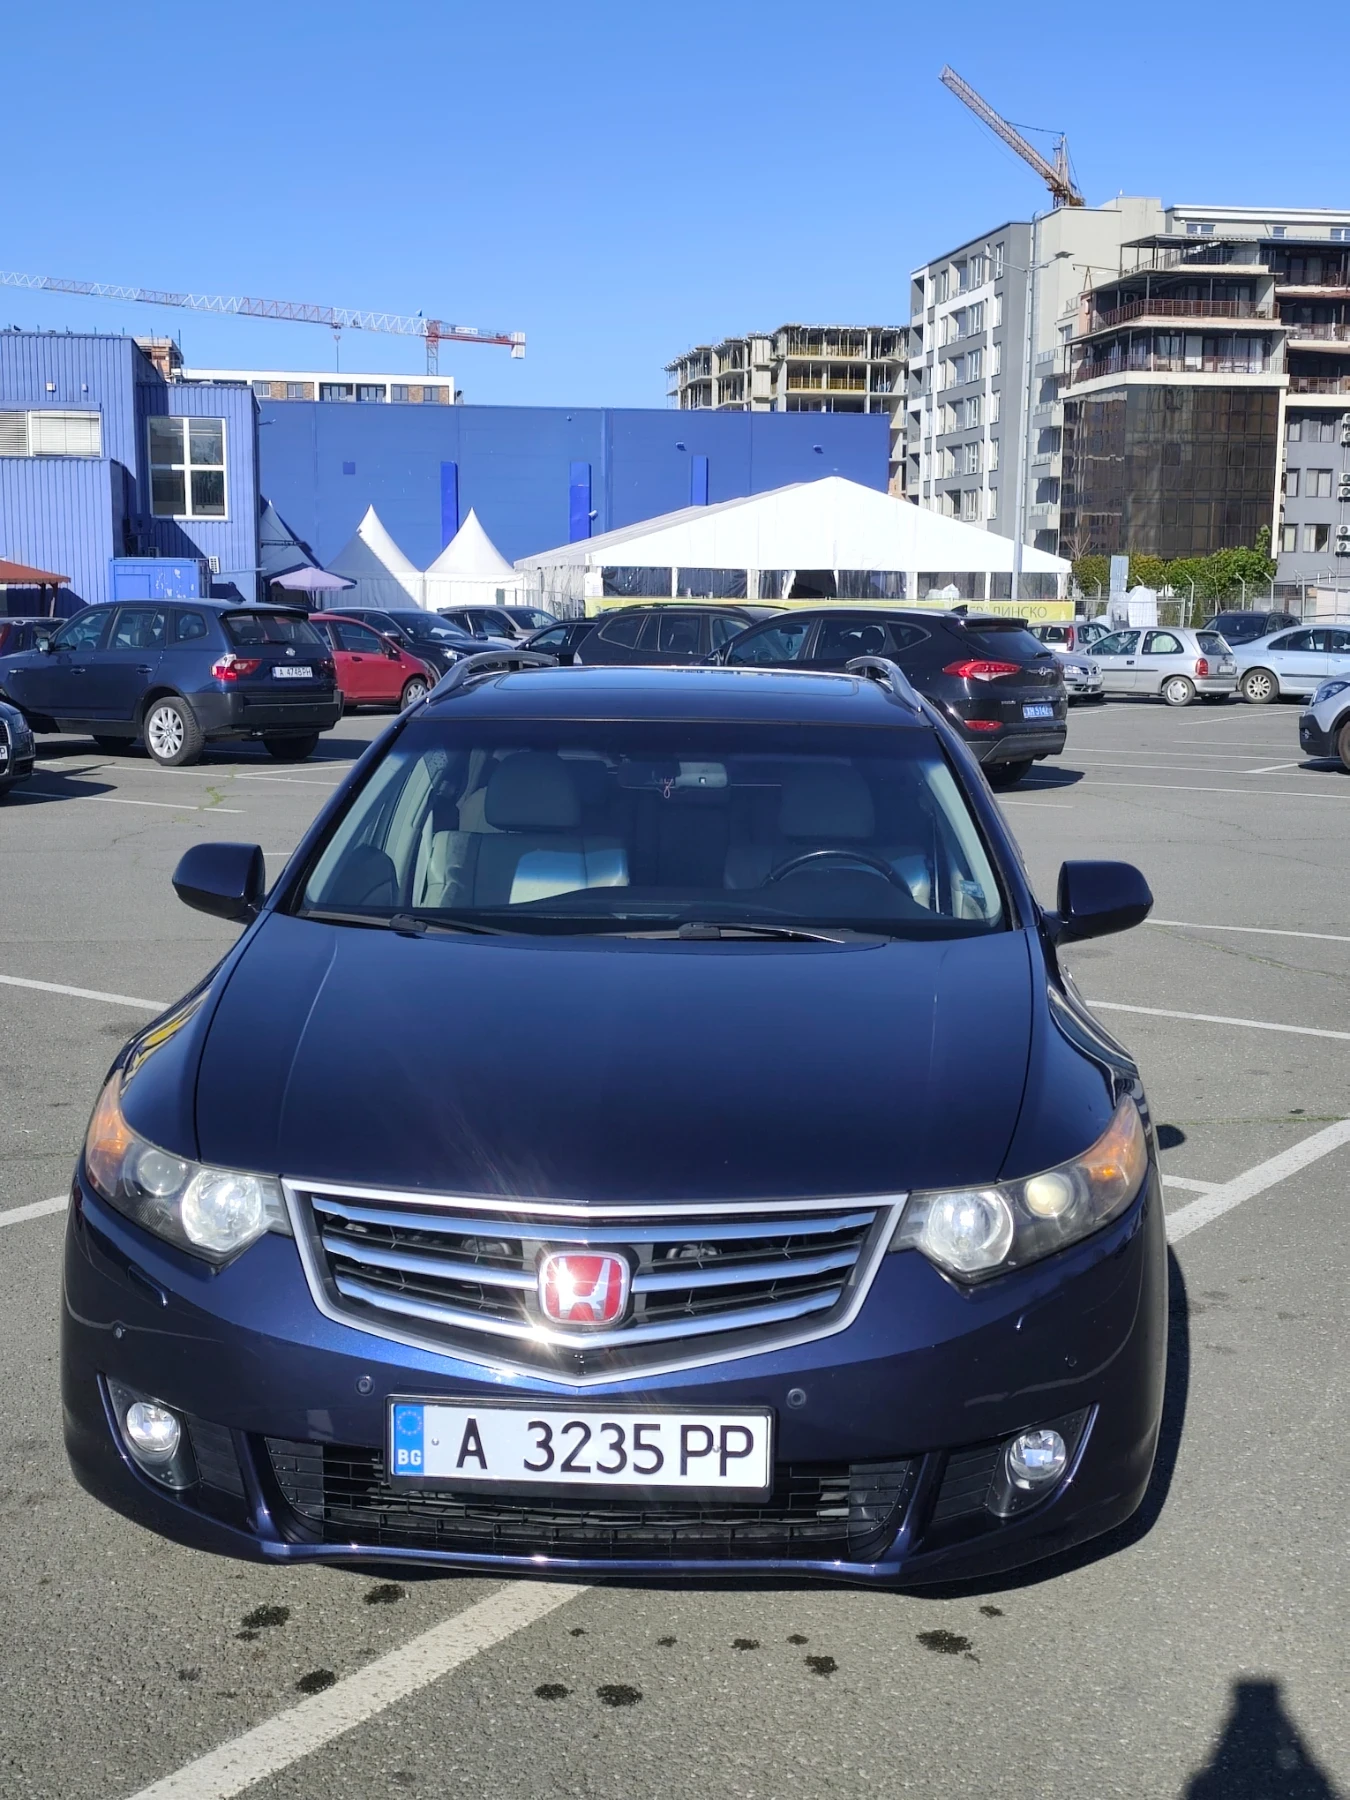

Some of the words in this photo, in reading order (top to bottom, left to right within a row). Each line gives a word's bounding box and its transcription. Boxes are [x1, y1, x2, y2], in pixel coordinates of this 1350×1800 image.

[969, 606, 1047, 618] ДИНСКО
[456, 1417, 488, 1470] A
[397, 1449, 422, 1466] BG
